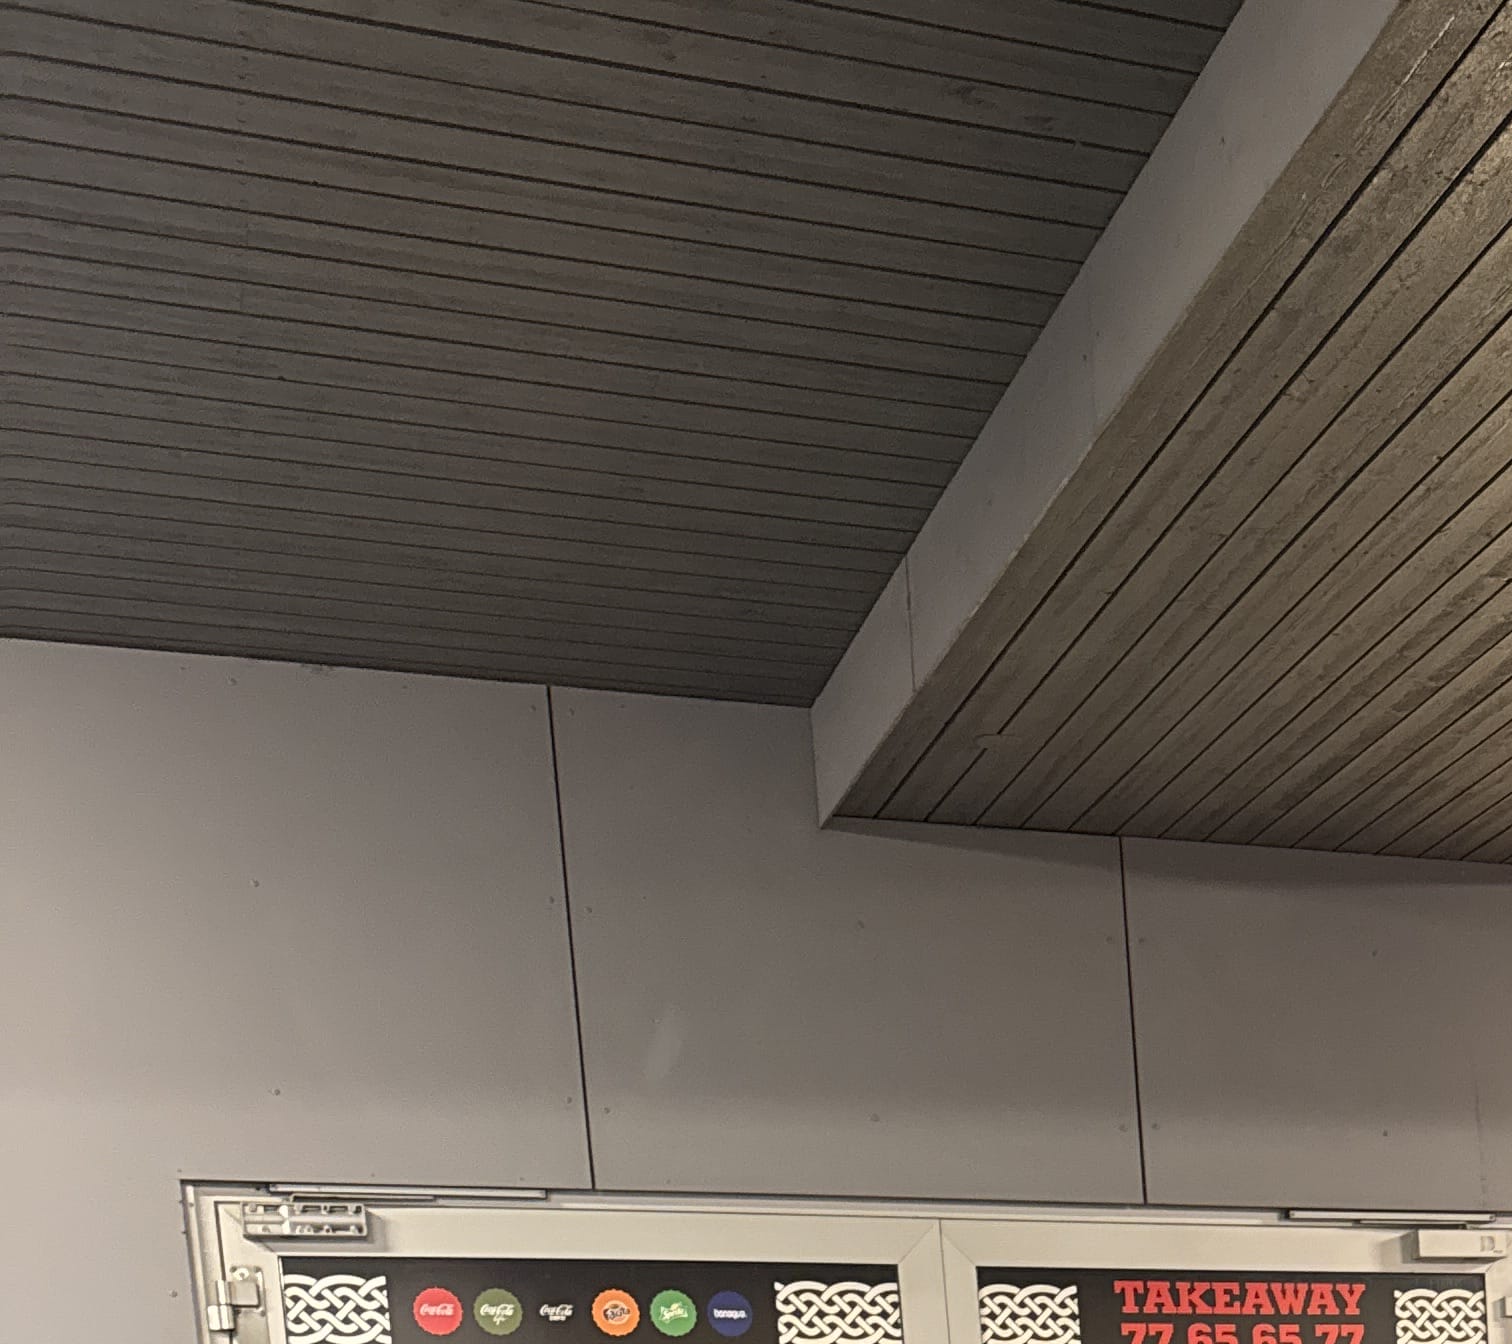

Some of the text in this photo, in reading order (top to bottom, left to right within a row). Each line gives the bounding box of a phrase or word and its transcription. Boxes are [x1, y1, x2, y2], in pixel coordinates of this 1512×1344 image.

[1113, 1280, 1366, 1316] TAKEAWAY
[479, 1303, 515, 1317] Coca-Cola
[538, 1303, 575, 1317] Coca-Cola
